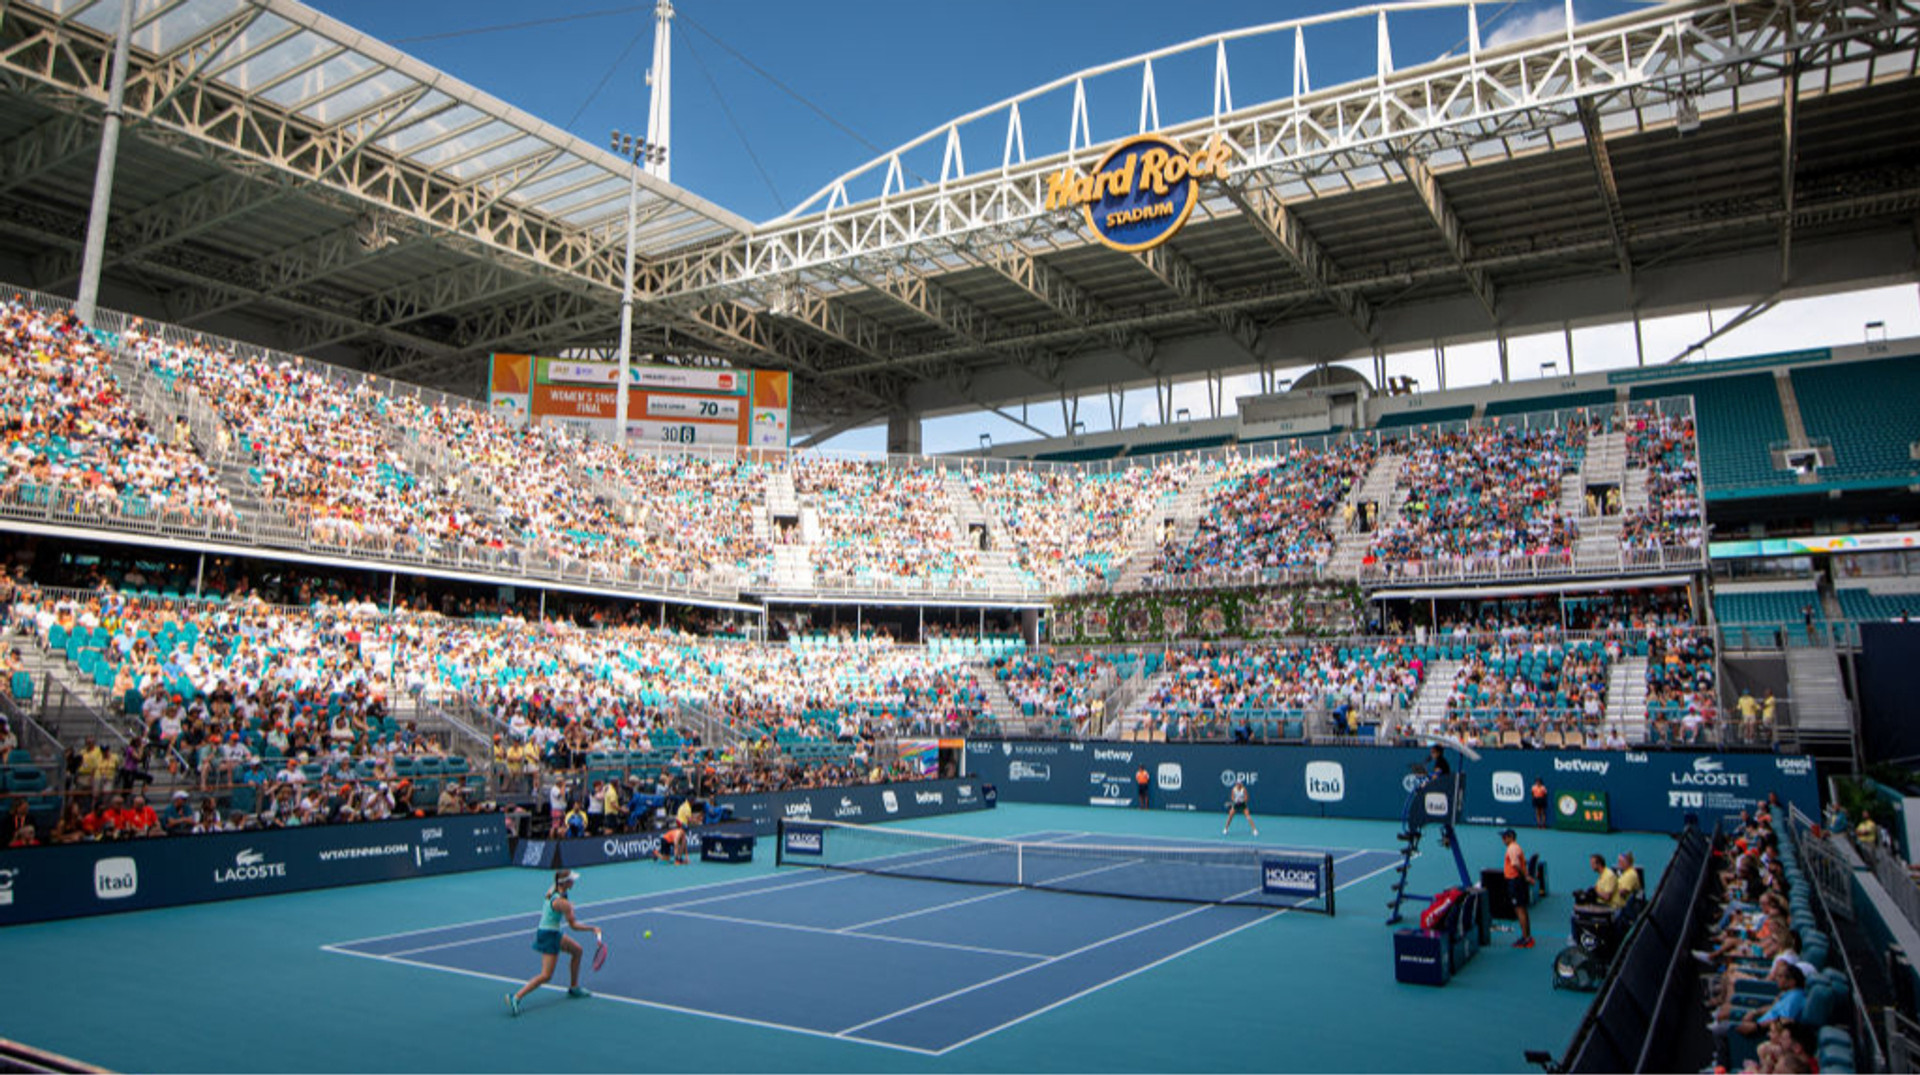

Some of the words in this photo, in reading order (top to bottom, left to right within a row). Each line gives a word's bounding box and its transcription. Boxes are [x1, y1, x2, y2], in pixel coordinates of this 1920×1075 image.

[1045, 153, 1137, 211] Hard
[1138, 133, 1232, 195] Rock
[1106, 200, 1174, 228] STADIUM
[550, 389, 592, 402] WOMEN'S
[576, 402, 602, 415] FINAL
[699, 401, 719, 416] 70
[661, 426, 679, 442] 30
[1094, 748, 1133, 764] betway
[1554, 757, 1610, 776] betway
[1237, 771, 1259, 786] PIF
[1309, 777, 1341, 794] itaú
[1671, 771, 1749, 788] LACOSTE
[1102, 783, 1120, 798] 70
[1668, 790, 1704, 808] FIU
[604, 836, 661, 858] Olympic
[215, 862, 287, 883] LACOSTE
[1265, 867, 1317, 885] HOLOGIC
[99, 872, 134, 891] itaú
